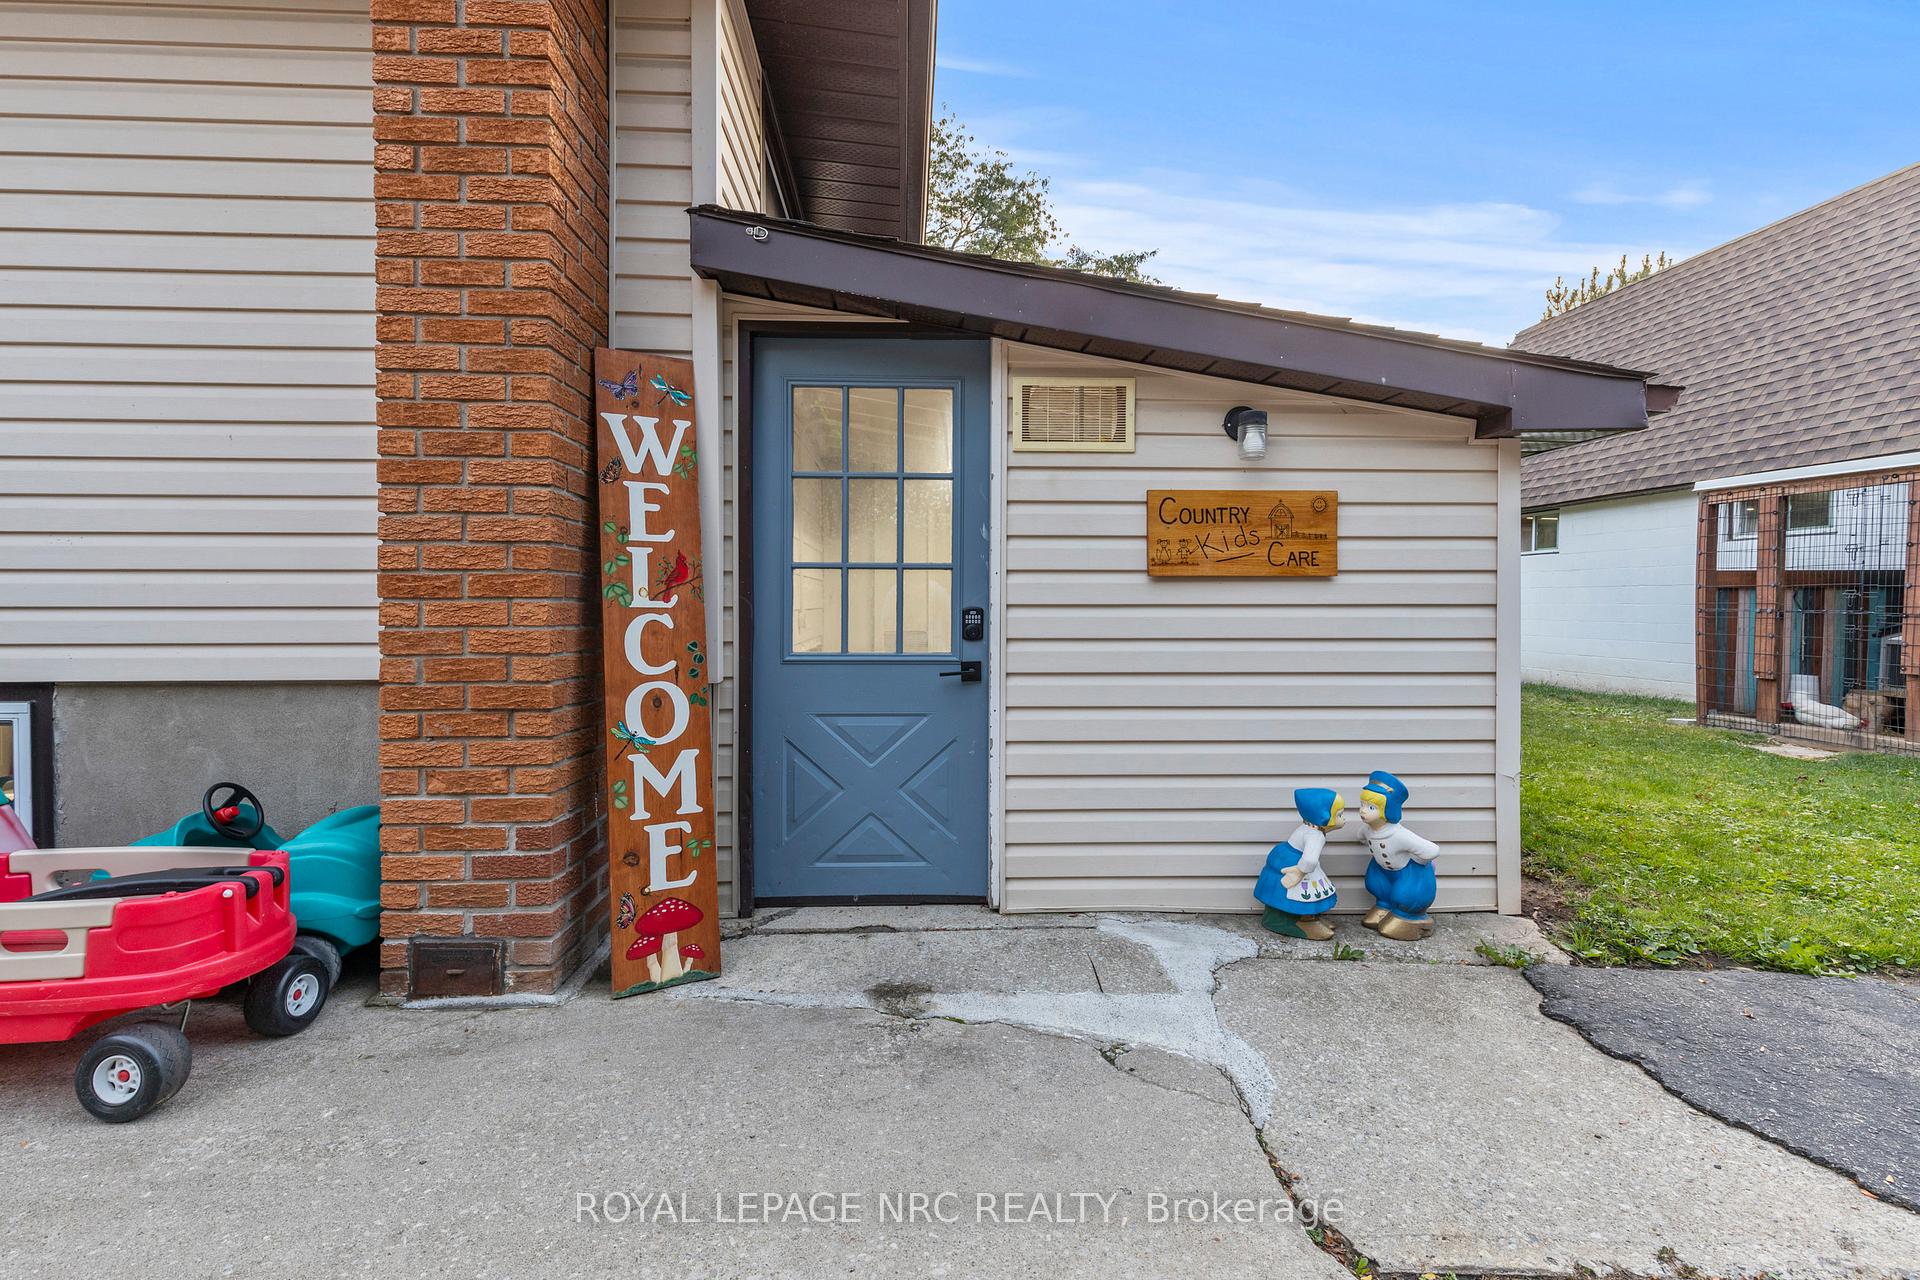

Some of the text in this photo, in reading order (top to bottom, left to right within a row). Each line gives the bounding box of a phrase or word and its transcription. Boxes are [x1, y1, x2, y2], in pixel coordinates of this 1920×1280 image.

[1158, 496, 1250, 525] COUNTRY
[1195, 525, 1260, 559] Kids
[1267, 541, 1320, 567] CARE
[600, 412, 703, 893] WELCOME
